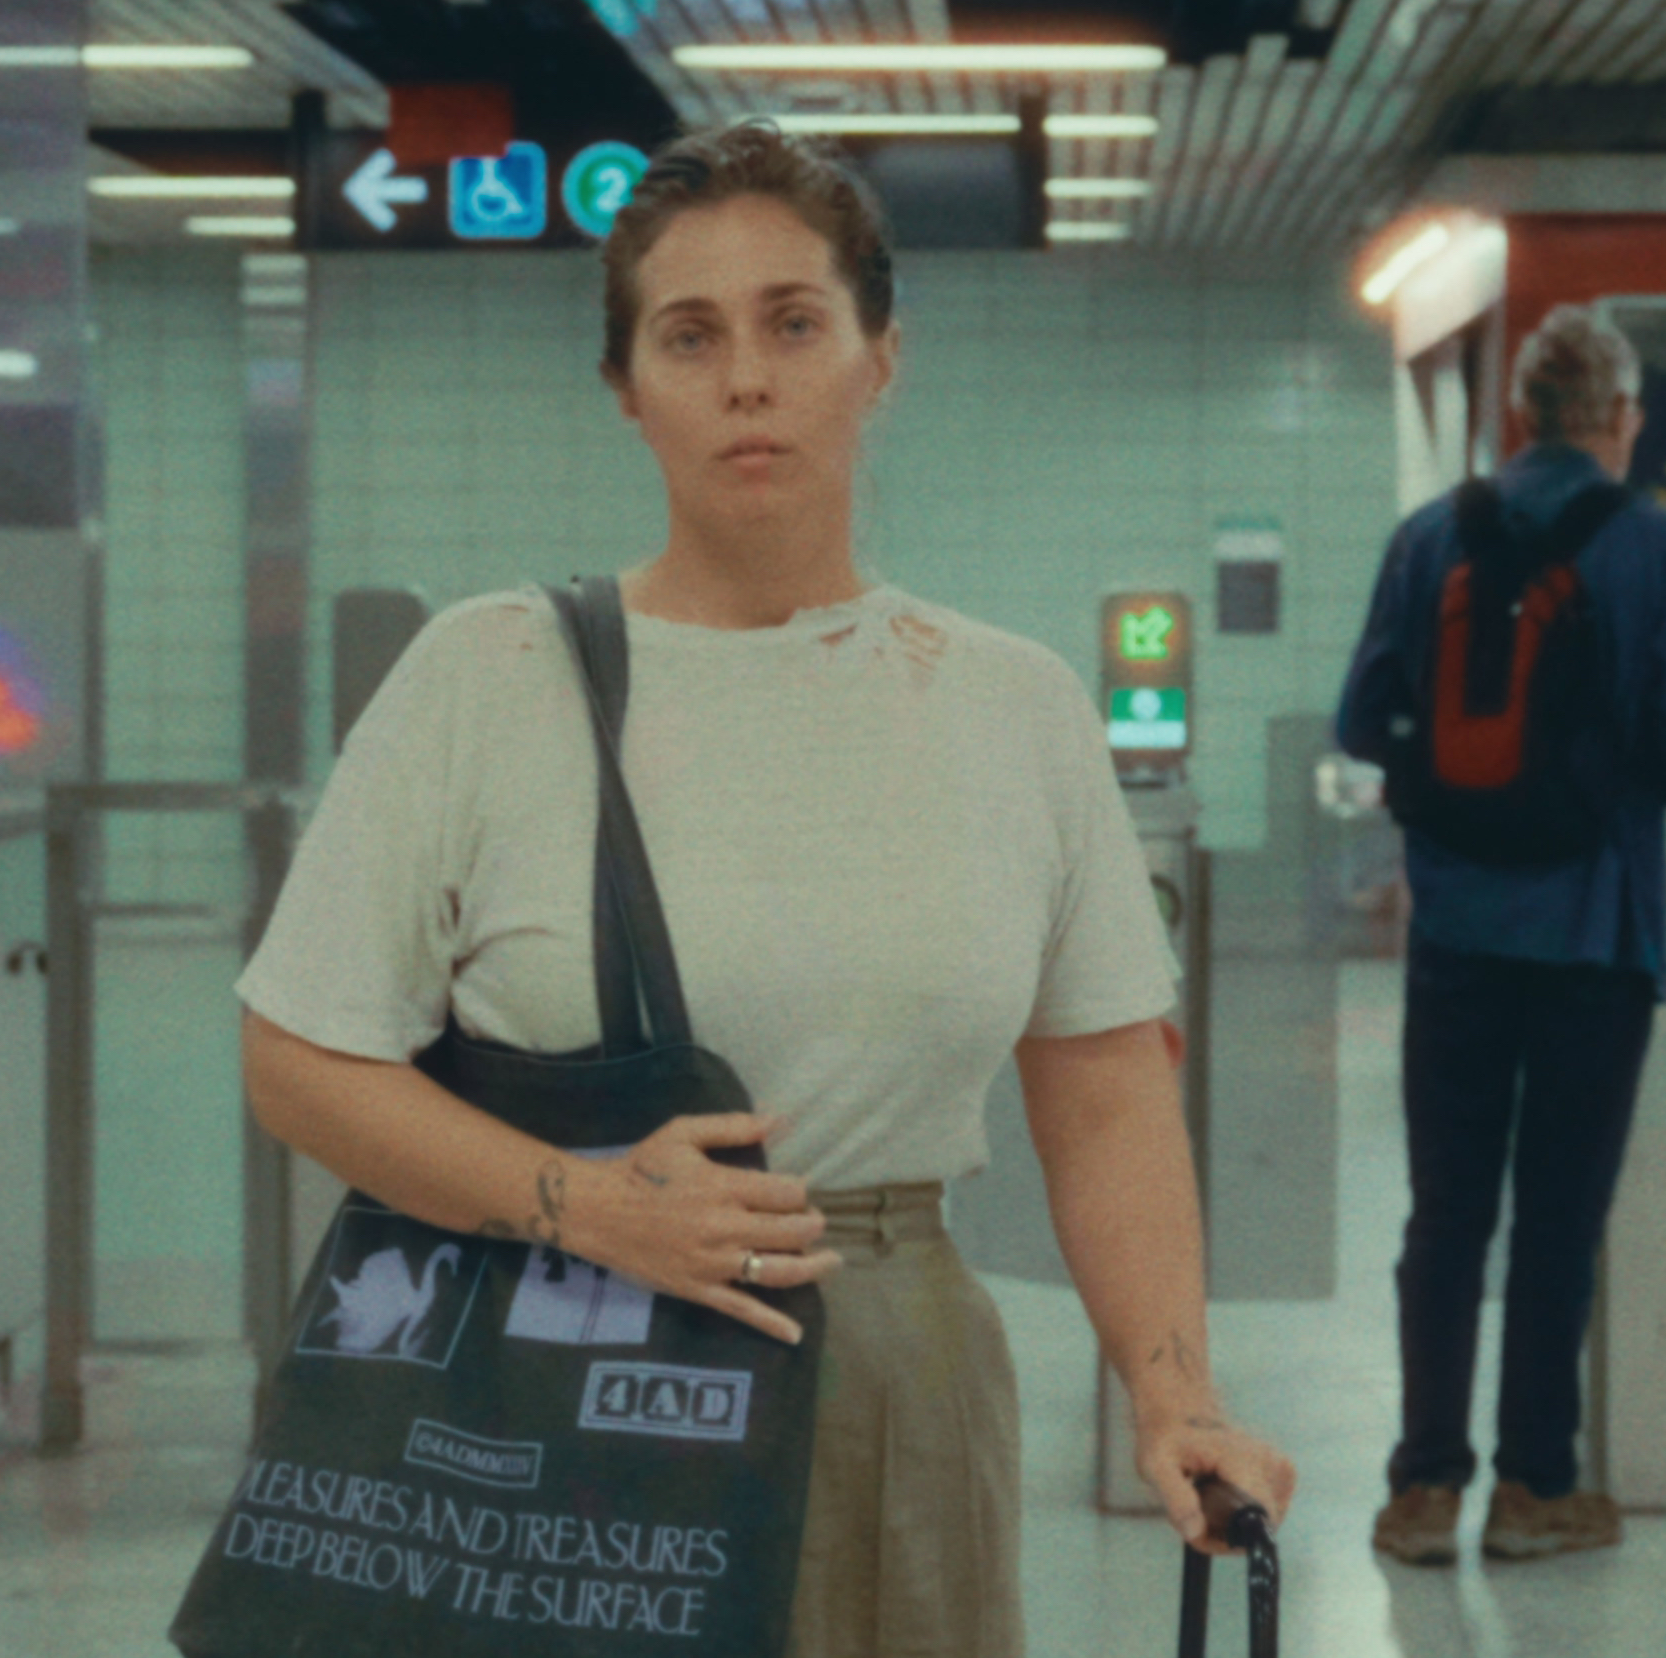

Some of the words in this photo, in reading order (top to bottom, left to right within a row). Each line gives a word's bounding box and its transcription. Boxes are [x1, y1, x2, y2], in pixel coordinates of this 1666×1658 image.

[597, 167, 627, 212] 2
[593, 1373, 738, 1427] 4AD
[408, 1490, 508, 1557] AND
[513, 1511, 730, 1578] TREASURES
[223, 1512, 316, 1570] DEEP
[312, 1528, 451, 1599] BELOW
[451, 1561, 527, 1621] THE
[526, 1574, 708, 1640] SURFACE
